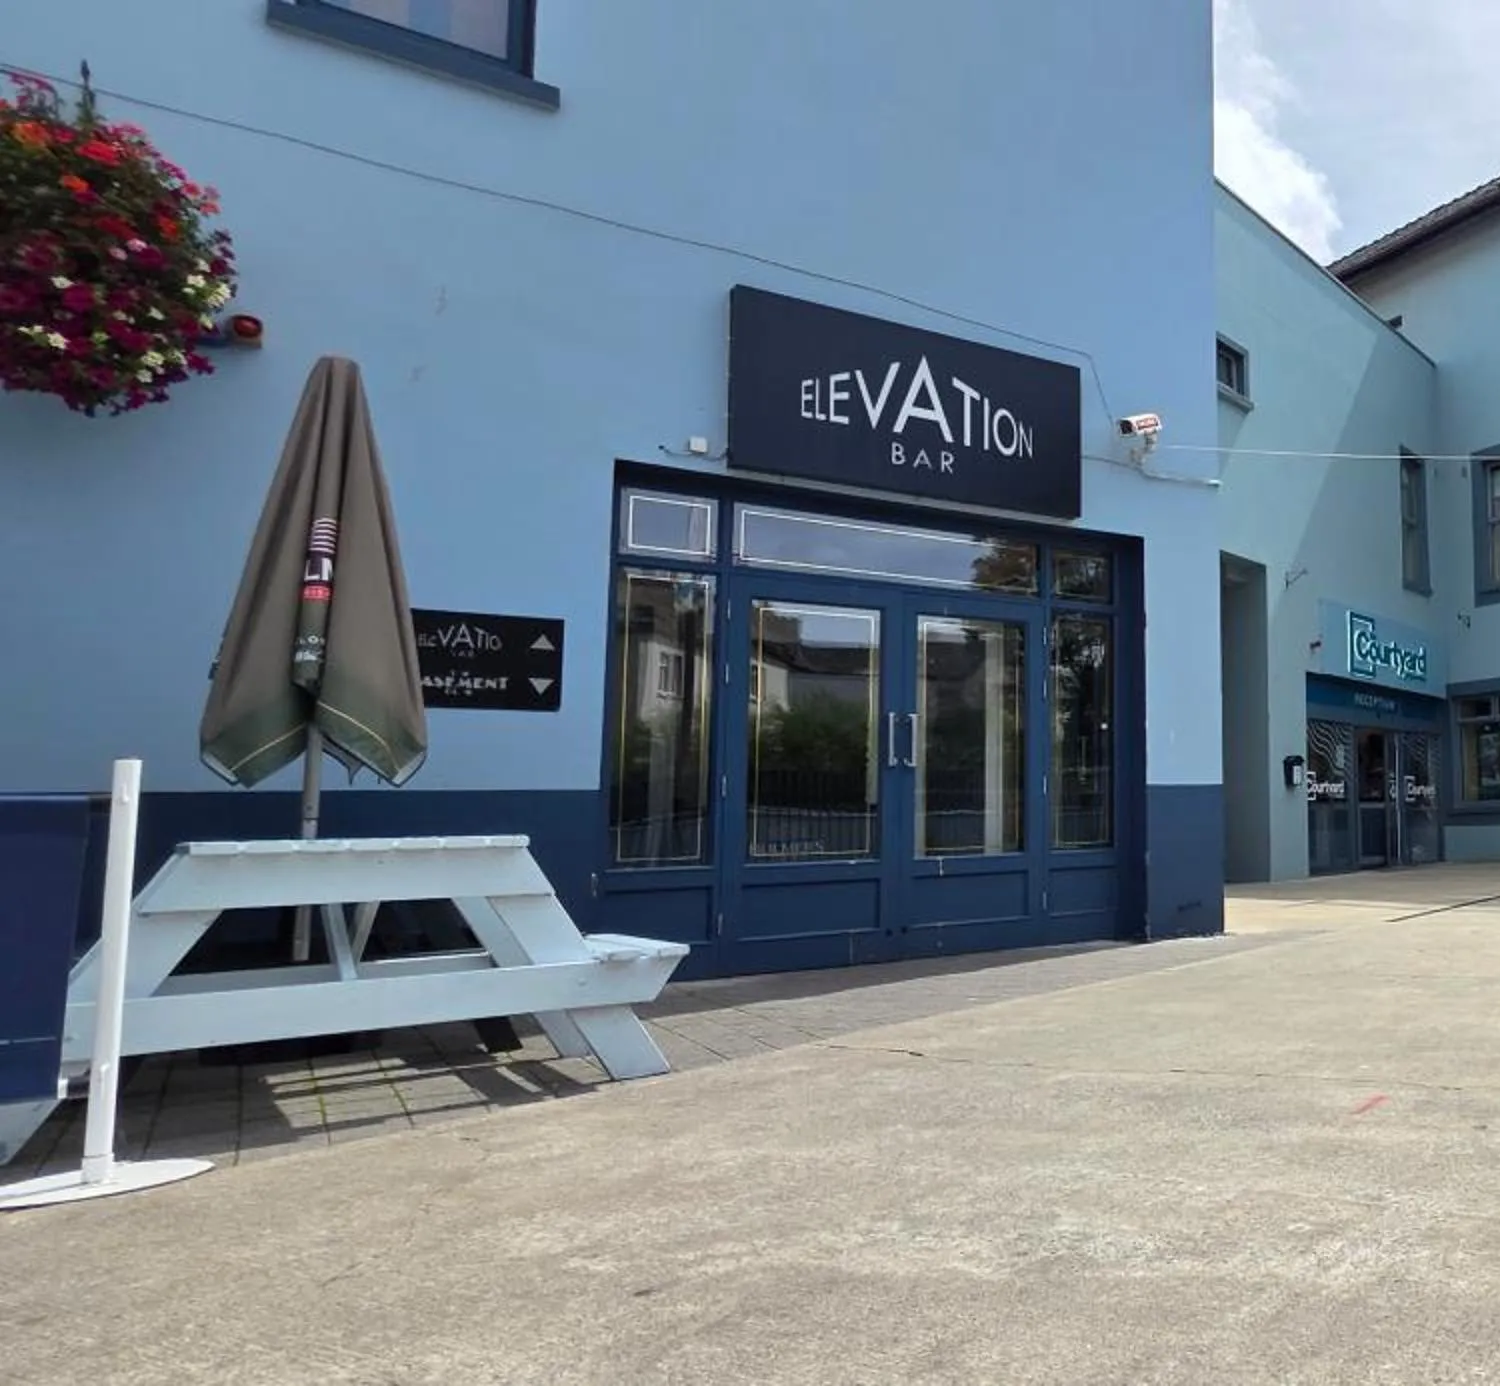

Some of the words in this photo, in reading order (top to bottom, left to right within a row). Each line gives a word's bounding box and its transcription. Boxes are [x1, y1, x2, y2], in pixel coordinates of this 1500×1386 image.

[800, 355, 1034, 460] ELEVATION
[890, 441, 955, 475] BAR
[1352, 629, 1427, 677] Courtyard
[420, 675, 510, 690] ASEMENT
